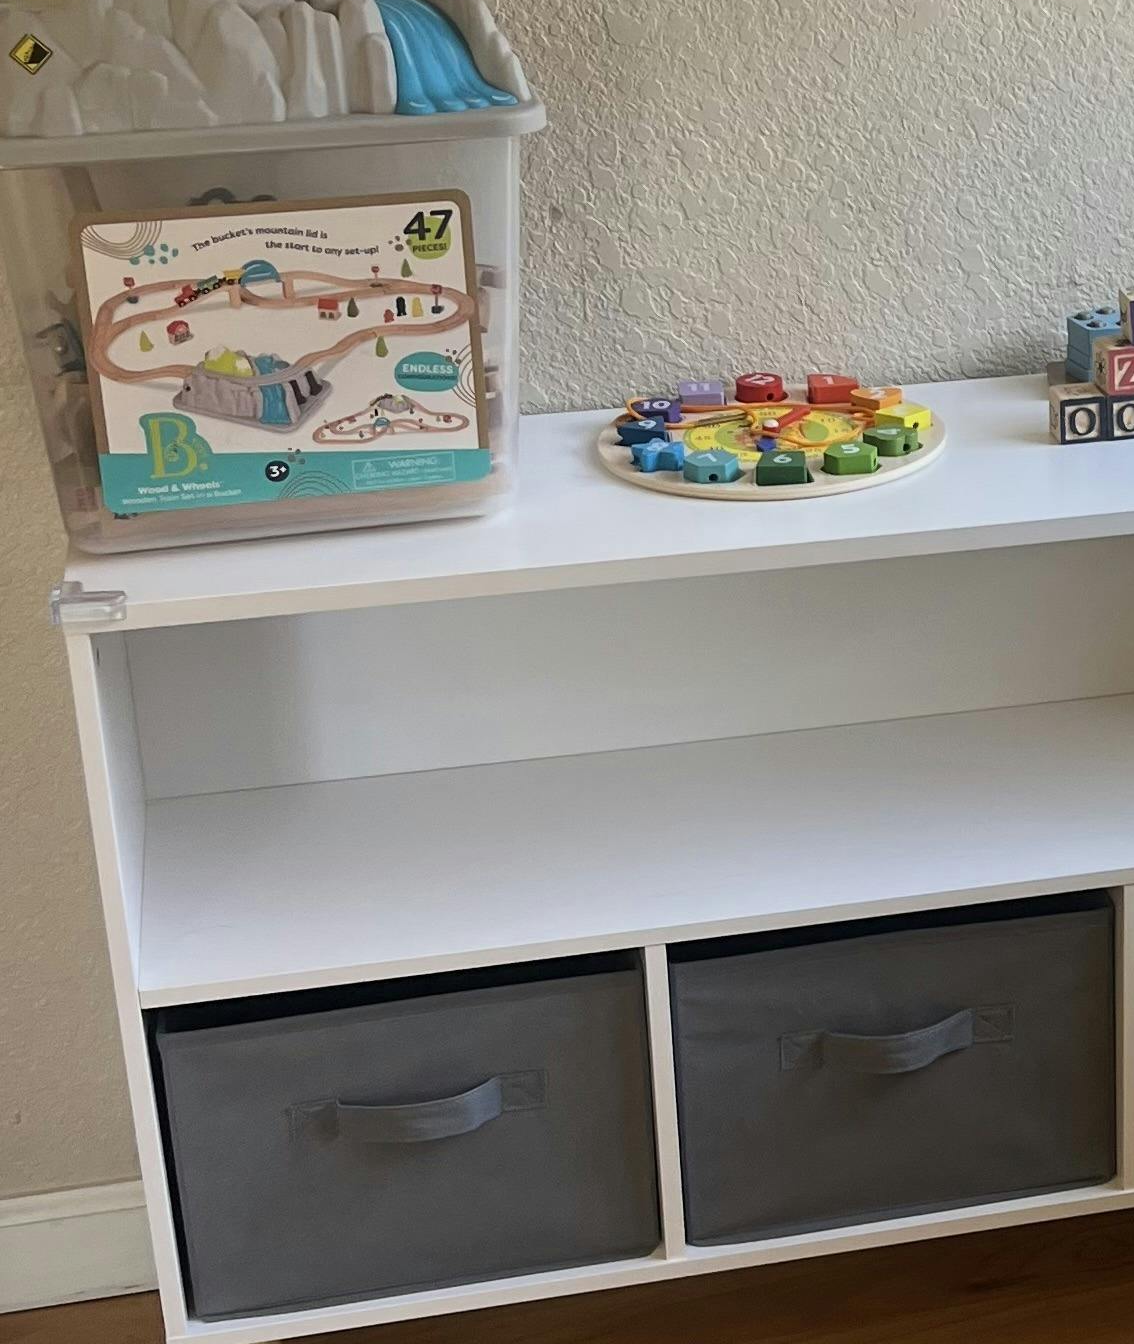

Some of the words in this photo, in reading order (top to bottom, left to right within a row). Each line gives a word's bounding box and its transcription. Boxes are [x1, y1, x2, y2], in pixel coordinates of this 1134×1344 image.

[403, 209, 453, 241] 47
[191, 239, 212, 252] The
[212, 227, 254, 244] bucket's
[255, 226, 304, 237] mountain
[305, 228, 319, 239] lid
[319, 230, 329, 240] is
[265, 240, 283, 249] the
[284, 241, 309, 253] start
[311, 244, 323, 254] to
[324, 247, 343, 258] any
[344, 245, 380, 257] set-up!
[412, 243, 448, 253] PIECES!
[402, 363, 454, 375] ENDLESS
[745, 374, 776, 385] 12
[823, 376, 835, 385] 1
[687, 382, 710, 392] 11
[642, 400, 671, 410] 10
[638, 419, 657, 430] 9
[1068, 407, 1098, 436] O
[840, 443, 860, 454] 5
[696, 453, 718, 463] 7
[772, 454, 793, 464] 6
[268, 464, 288, 478] 3+
[138, 484, 169, 496] Wood
[171, 482, 180, 493] &
